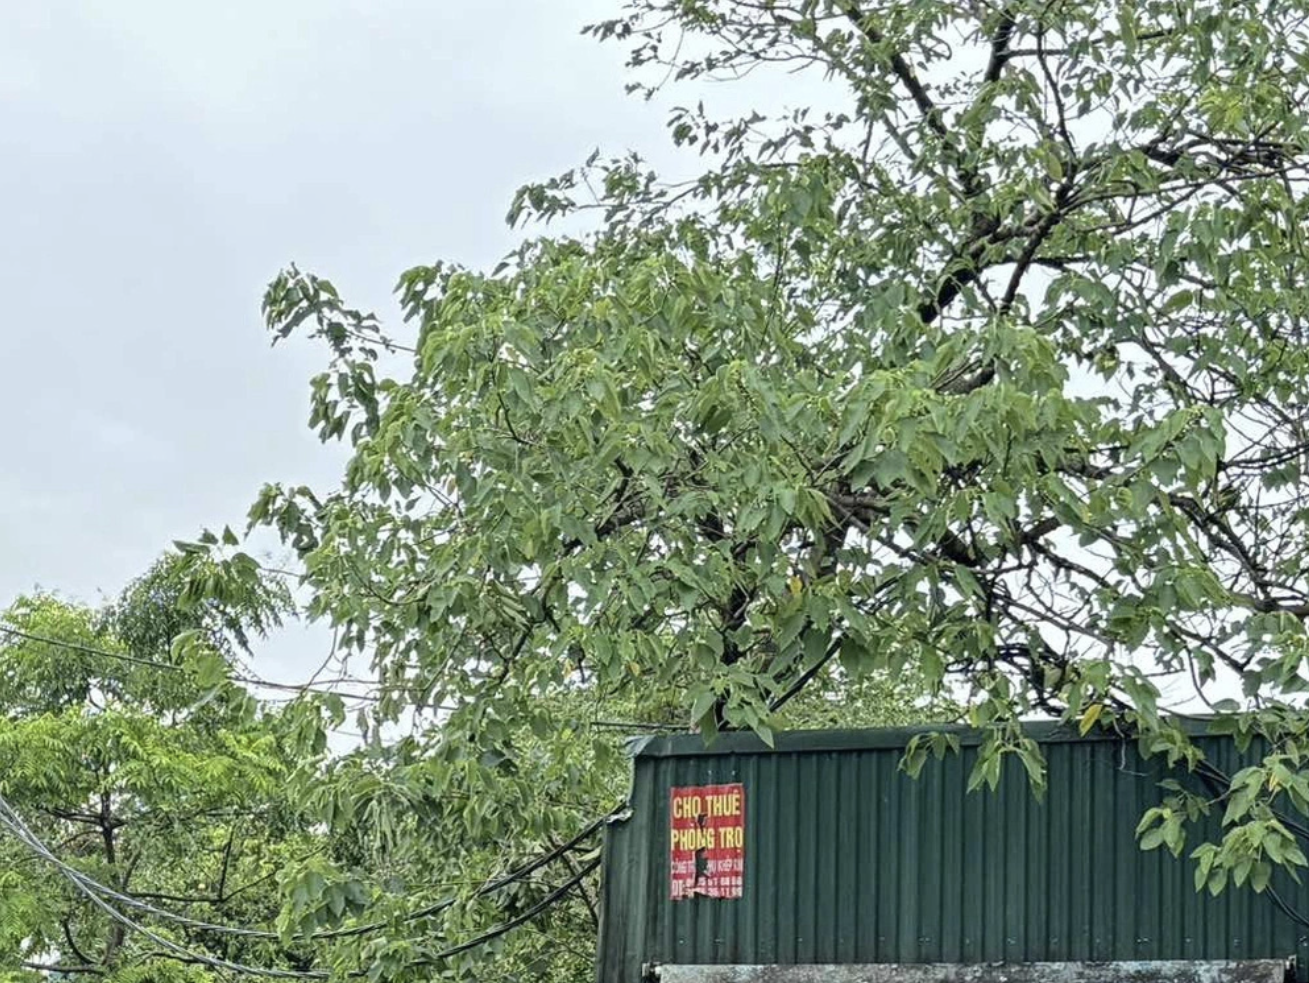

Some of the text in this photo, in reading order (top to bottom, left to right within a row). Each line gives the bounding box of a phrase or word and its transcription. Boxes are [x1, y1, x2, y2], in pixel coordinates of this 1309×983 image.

[673, 789, 741, 819] CHO THUÊ
[670, 823, 743, 853] PHÒNG TRỌ
